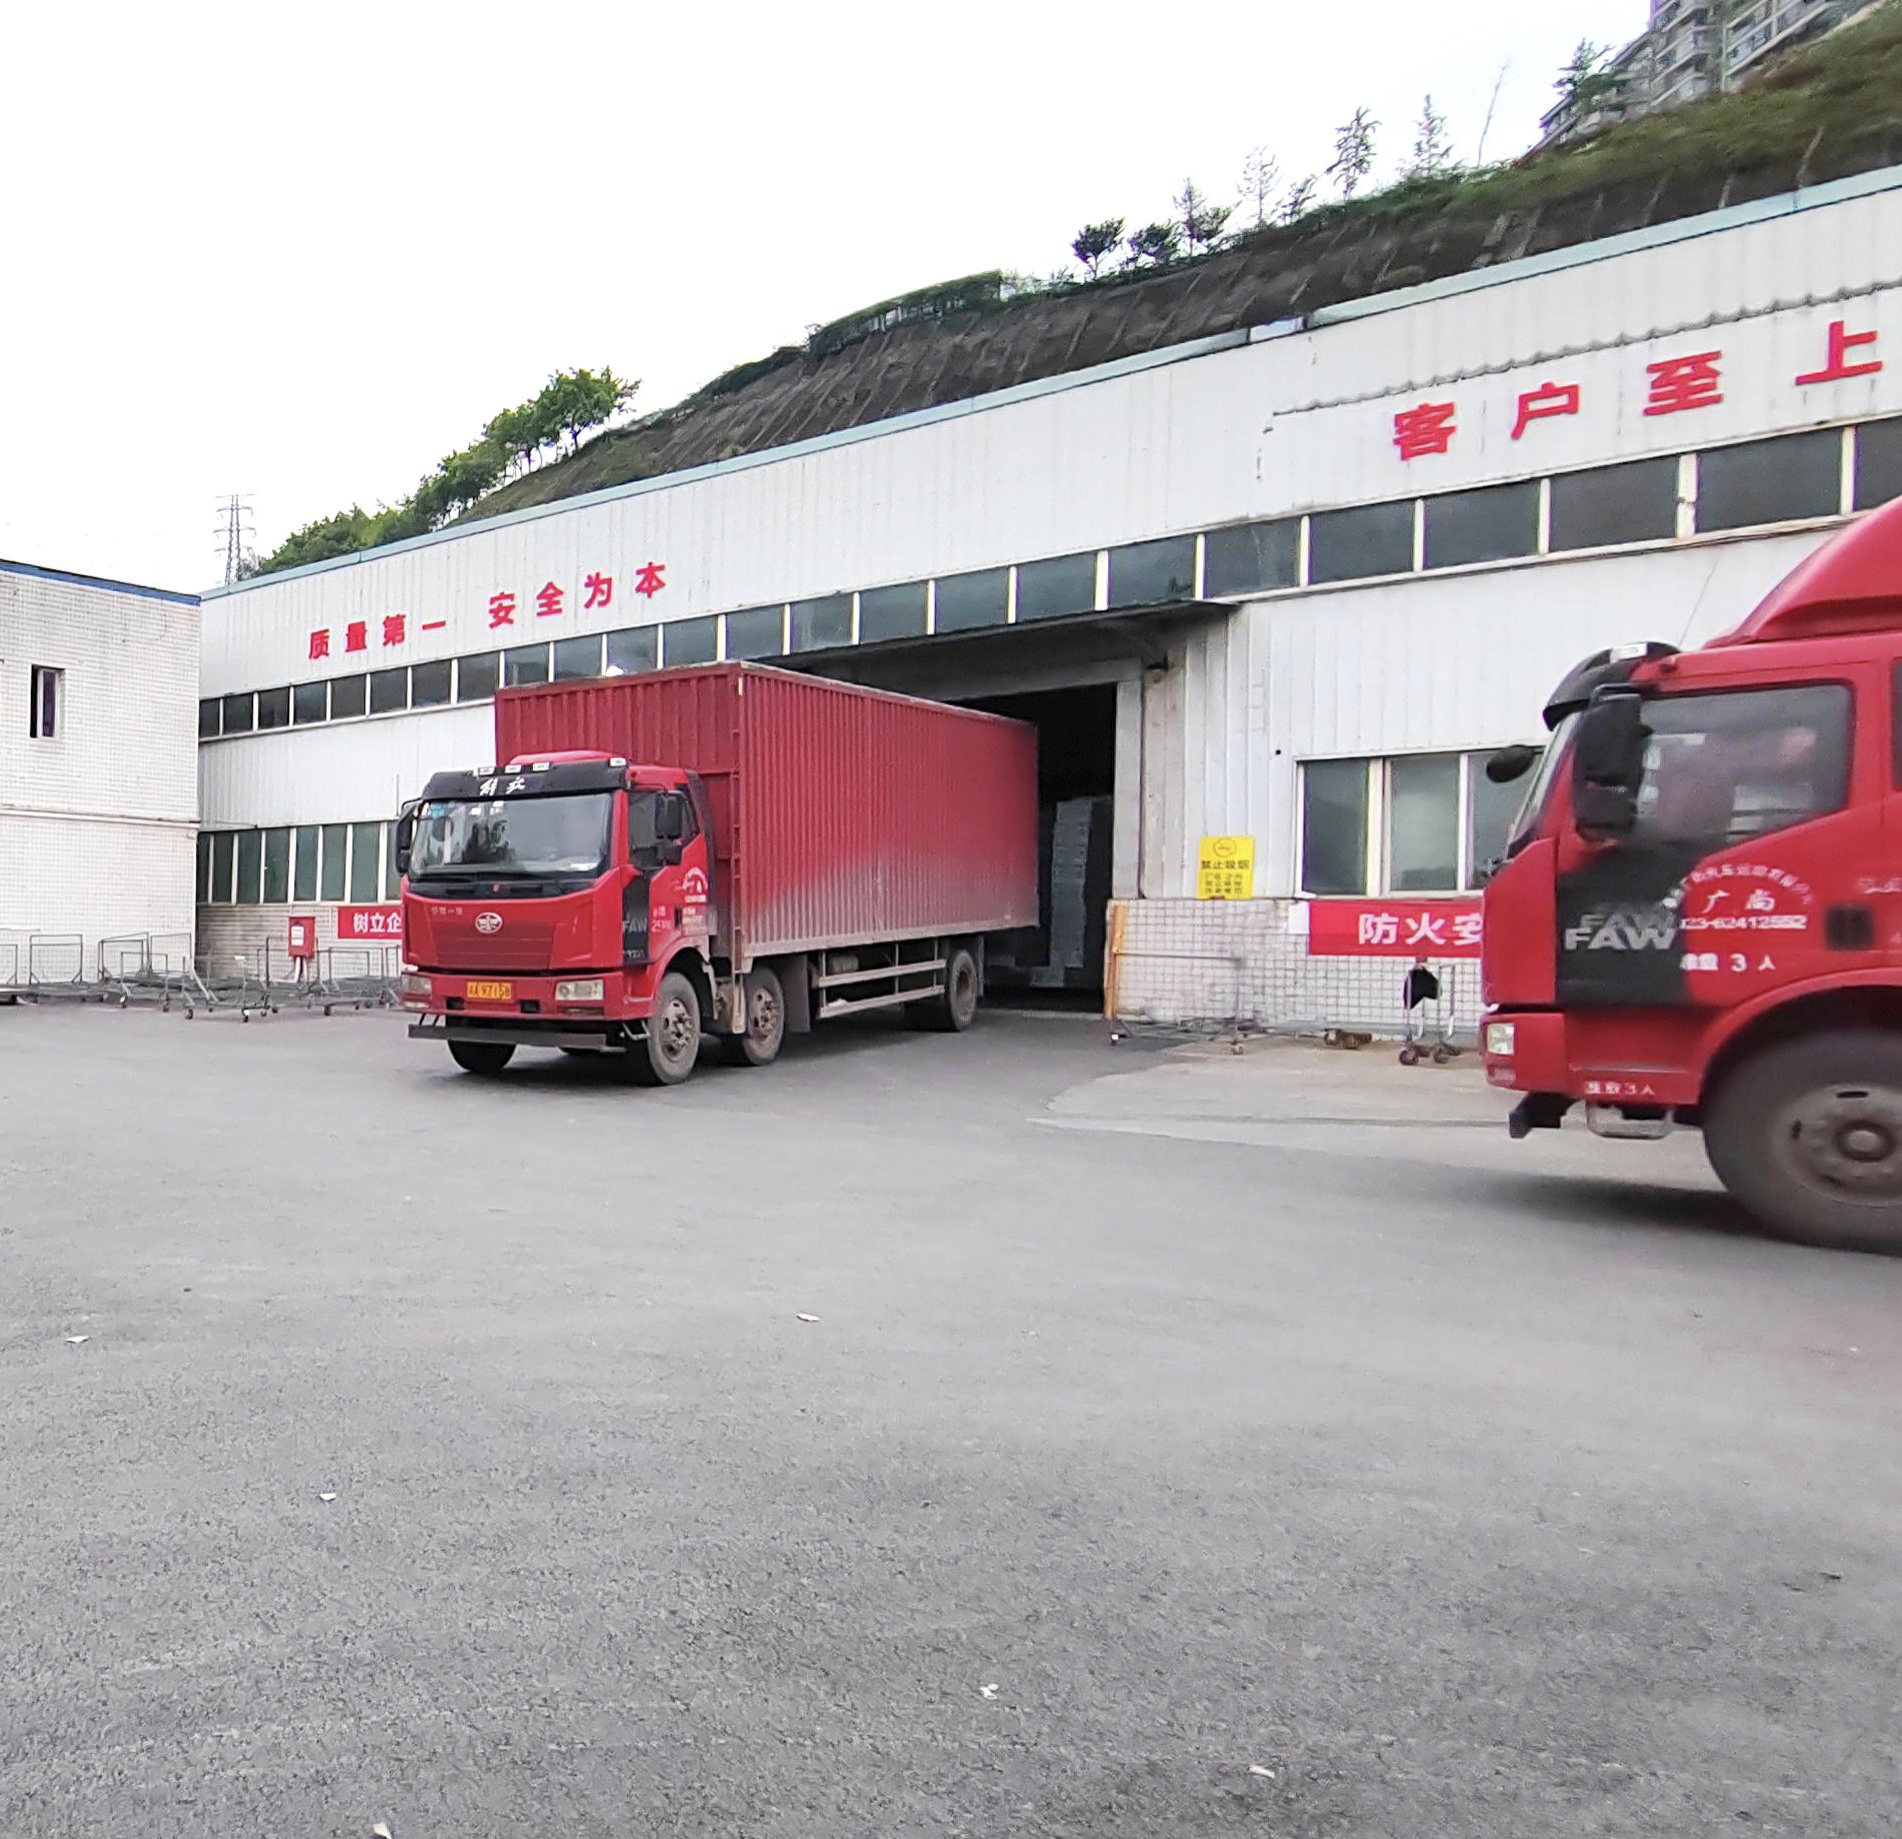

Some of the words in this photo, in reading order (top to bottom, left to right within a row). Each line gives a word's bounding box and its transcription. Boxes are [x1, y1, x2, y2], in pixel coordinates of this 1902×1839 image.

[1393, 320, 1883, 462] 客户至上
[308, 613, 447, 660] 质量第一
[488, 561, 667, 630] 安全为本
[353, 911, 402, 934] 树立企
[1564, 926, 1677, 951] FAW
